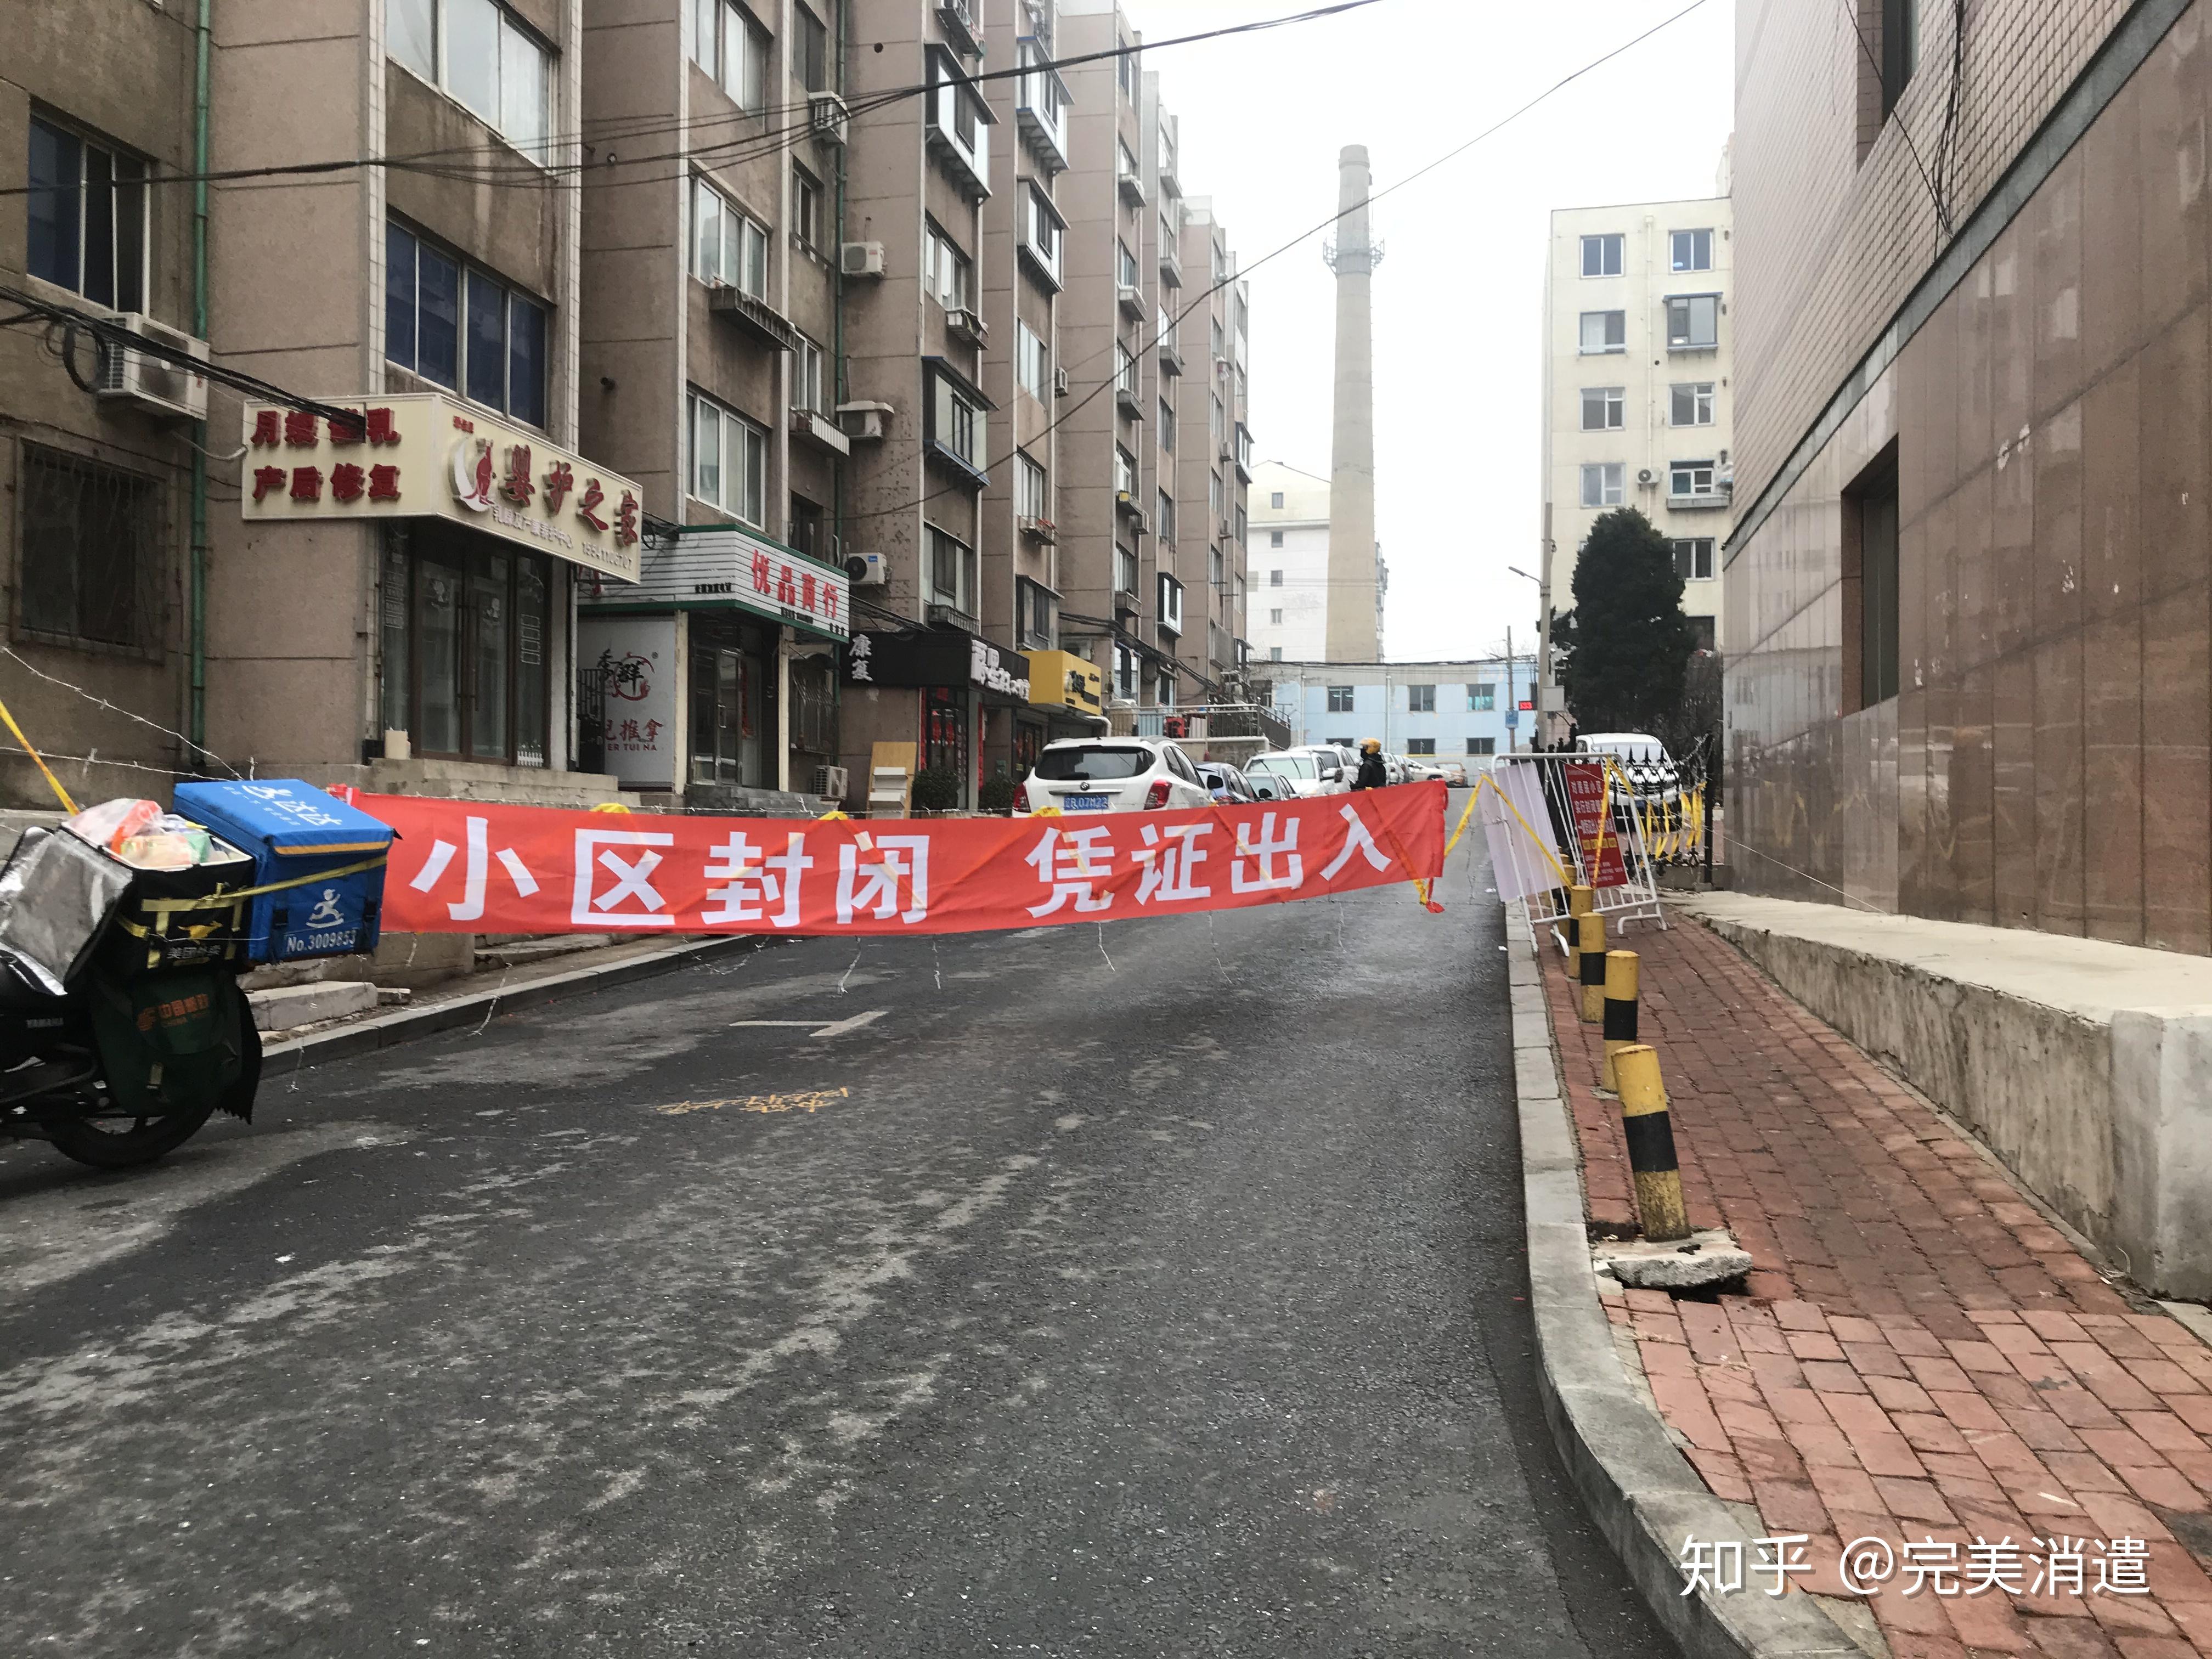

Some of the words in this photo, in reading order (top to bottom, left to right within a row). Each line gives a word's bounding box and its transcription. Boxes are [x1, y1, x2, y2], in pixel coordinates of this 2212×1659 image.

[252, 462, 402, 501] 产后修复
[1575, 799, 1604, 814] 实行封闭管
[409, 815, 930, 928] 小区封闭
[1024, 802, 1393, 919] 凭证出入
